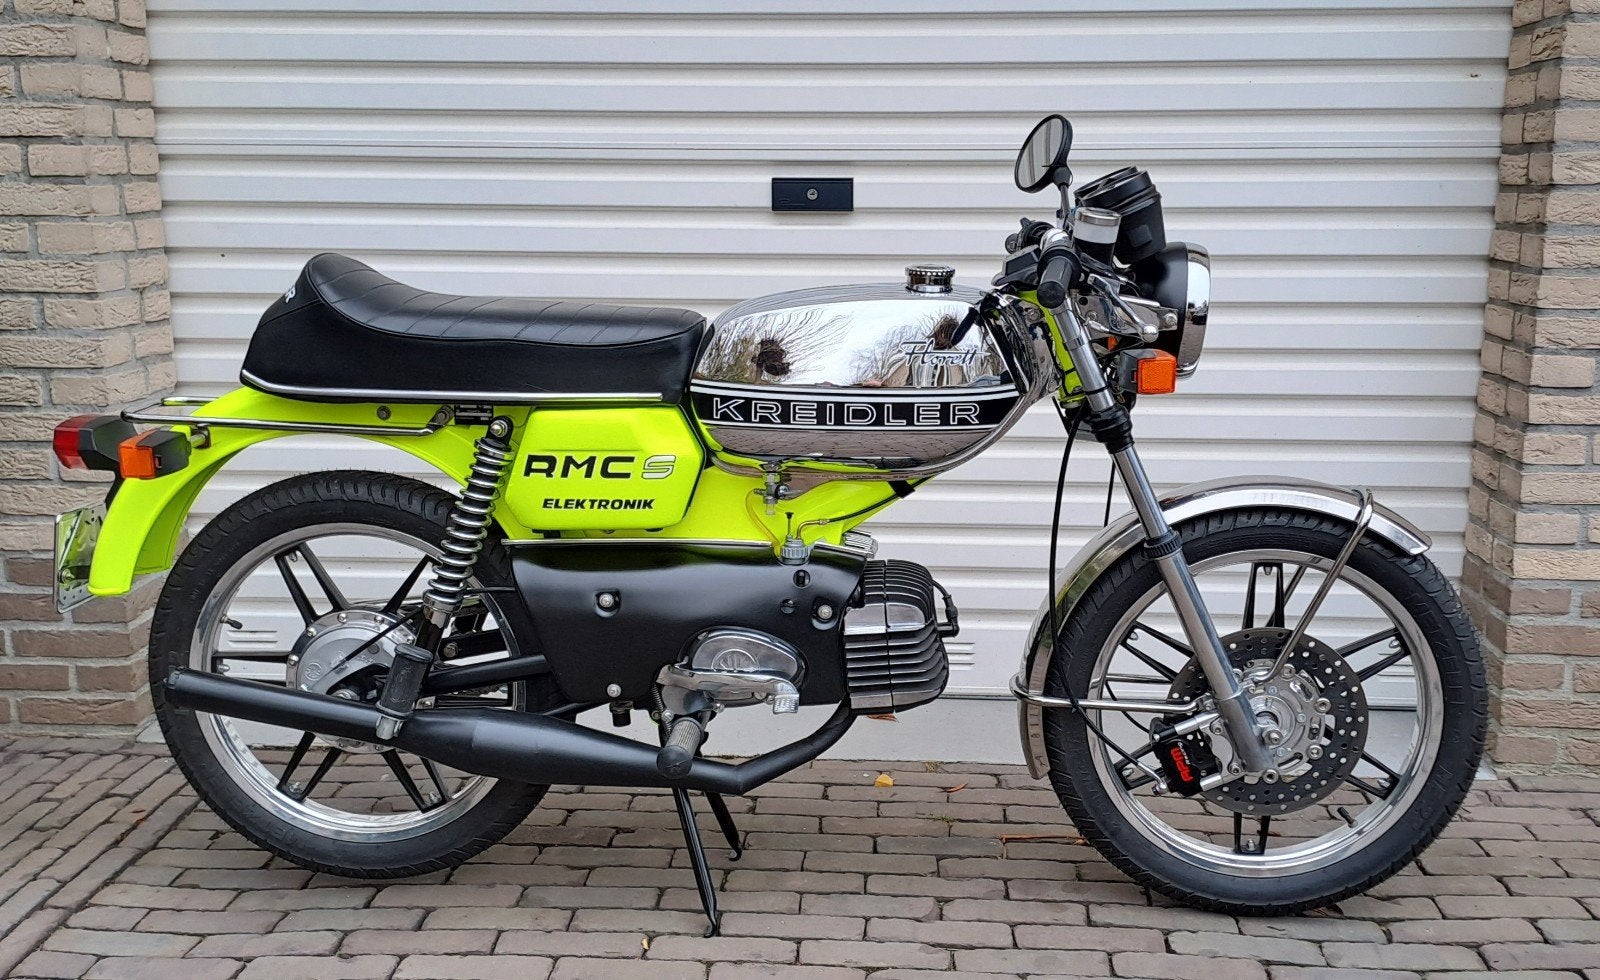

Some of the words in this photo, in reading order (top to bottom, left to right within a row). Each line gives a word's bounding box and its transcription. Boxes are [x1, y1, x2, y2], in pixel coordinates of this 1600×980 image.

[900, 337, 991, 366] Florett
[712, 397, 980, 426] KREIDLER
[542, 497, 656, 510] ELEKTRONIK
